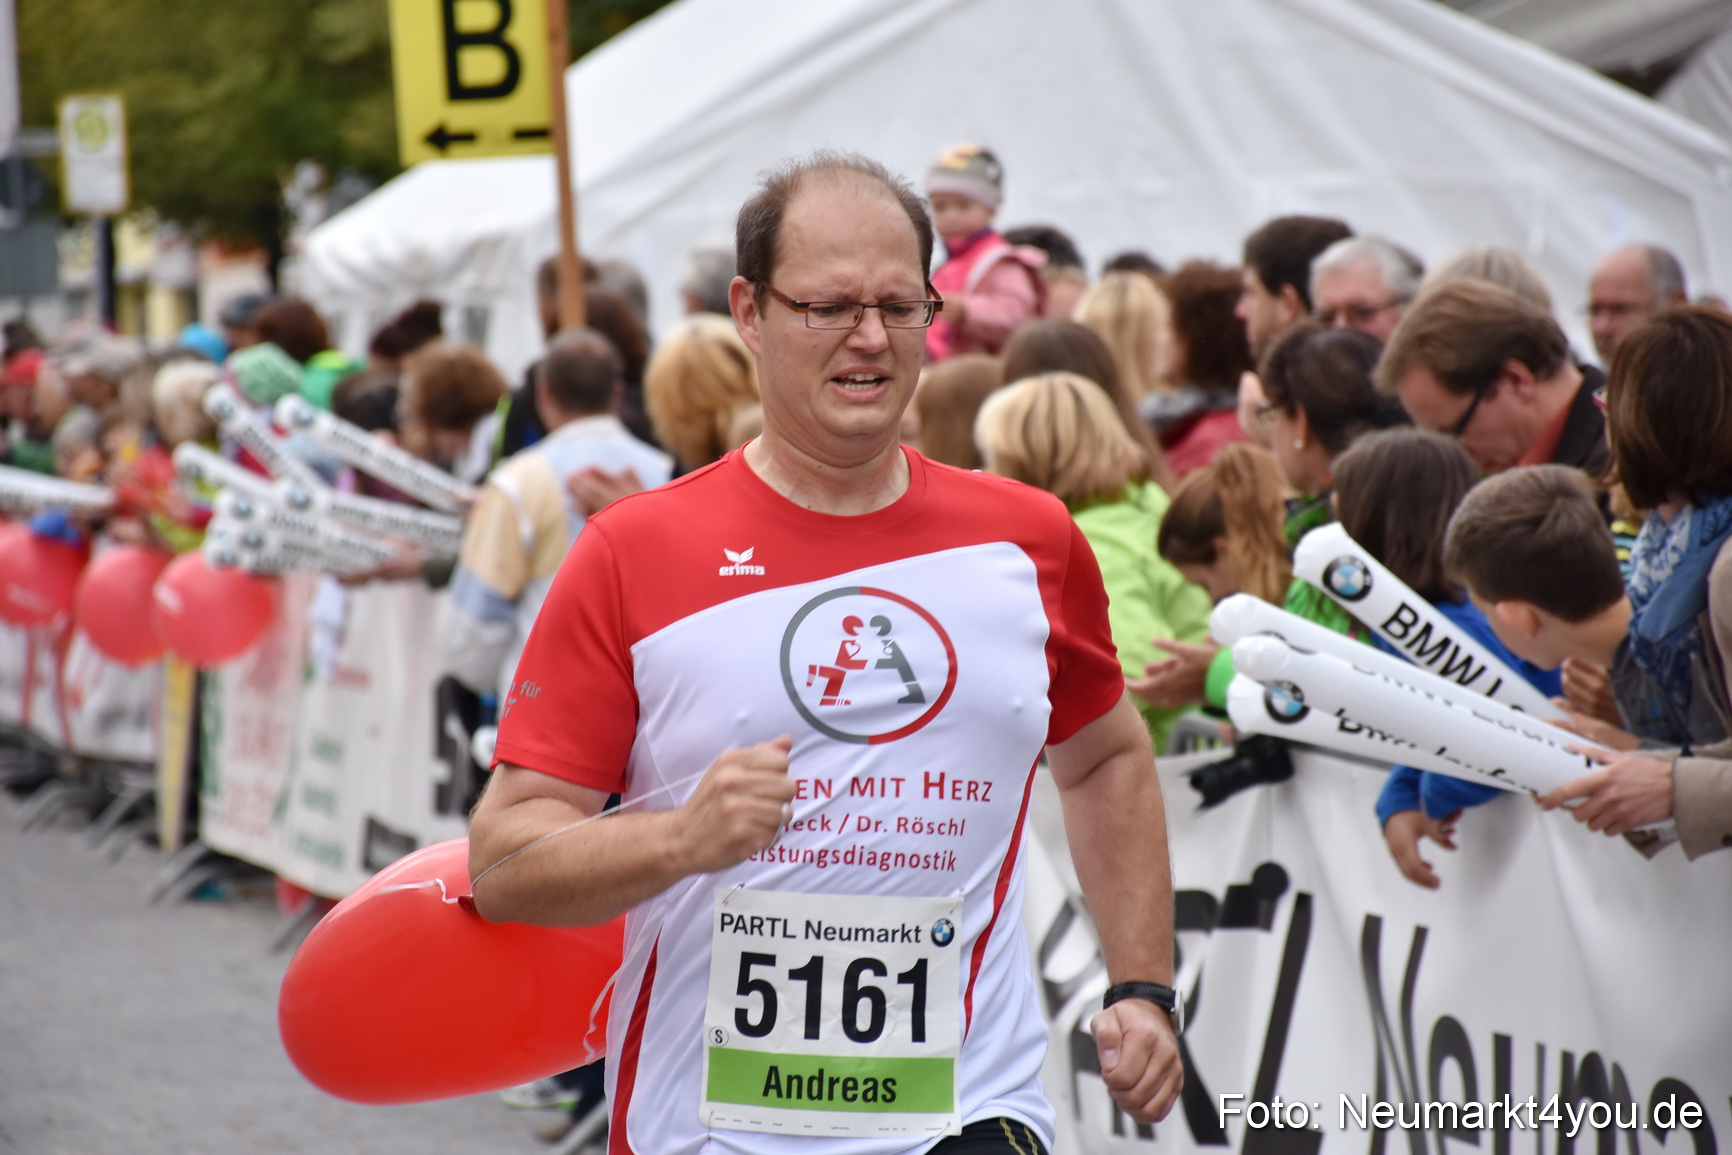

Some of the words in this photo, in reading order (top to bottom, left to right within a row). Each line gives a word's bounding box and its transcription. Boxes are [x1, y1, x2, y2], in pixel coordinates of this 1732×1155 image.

[442, 0, 520, 101] B
[719, 563, 766, 576] erima
[1380, 601, 1487, 686] BMW
[795, 778, 833, 800] EN
[850, 776, 906, 797] MIT
[837, 813, 850, 835] /
[856, 816, 888, 833] Dr.
[896, 816, 966, 836] Röschl
[749, 844, 957, 872] eistungsdiagnostik
[720, 912, 797, 939] PARTL
[804, 920, 922, 943] Neumarkt
[734, 951, 928, 1044] 5161
[762, 1065, 898, 1103] Andreas
